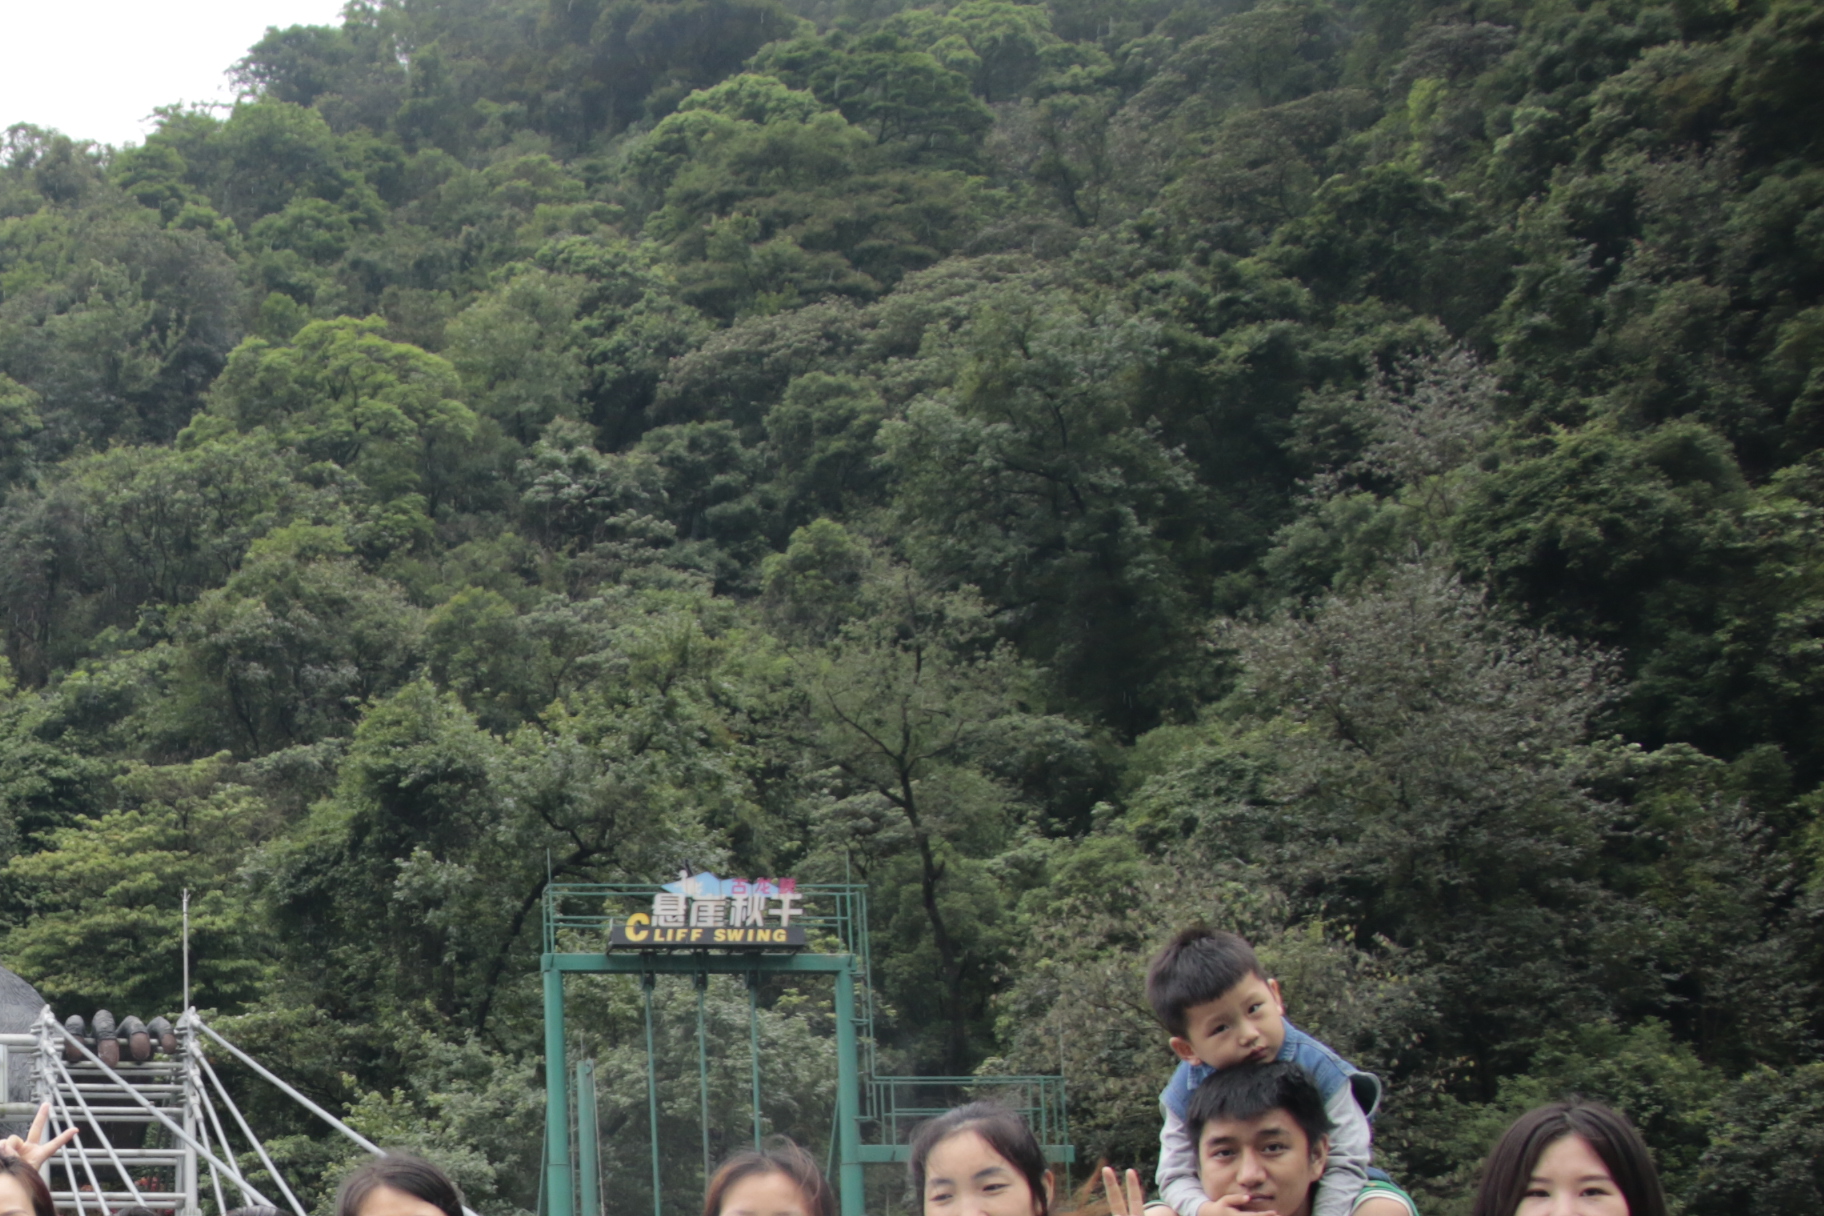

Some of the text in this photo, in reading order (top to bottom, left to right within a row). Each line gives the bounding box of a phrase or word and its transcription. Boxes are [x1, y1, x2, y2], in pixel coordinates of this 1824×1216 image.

[651, 892, 803, 928] 悬崖秋千
[625, 912, 788, 942] CLIFF SWING
